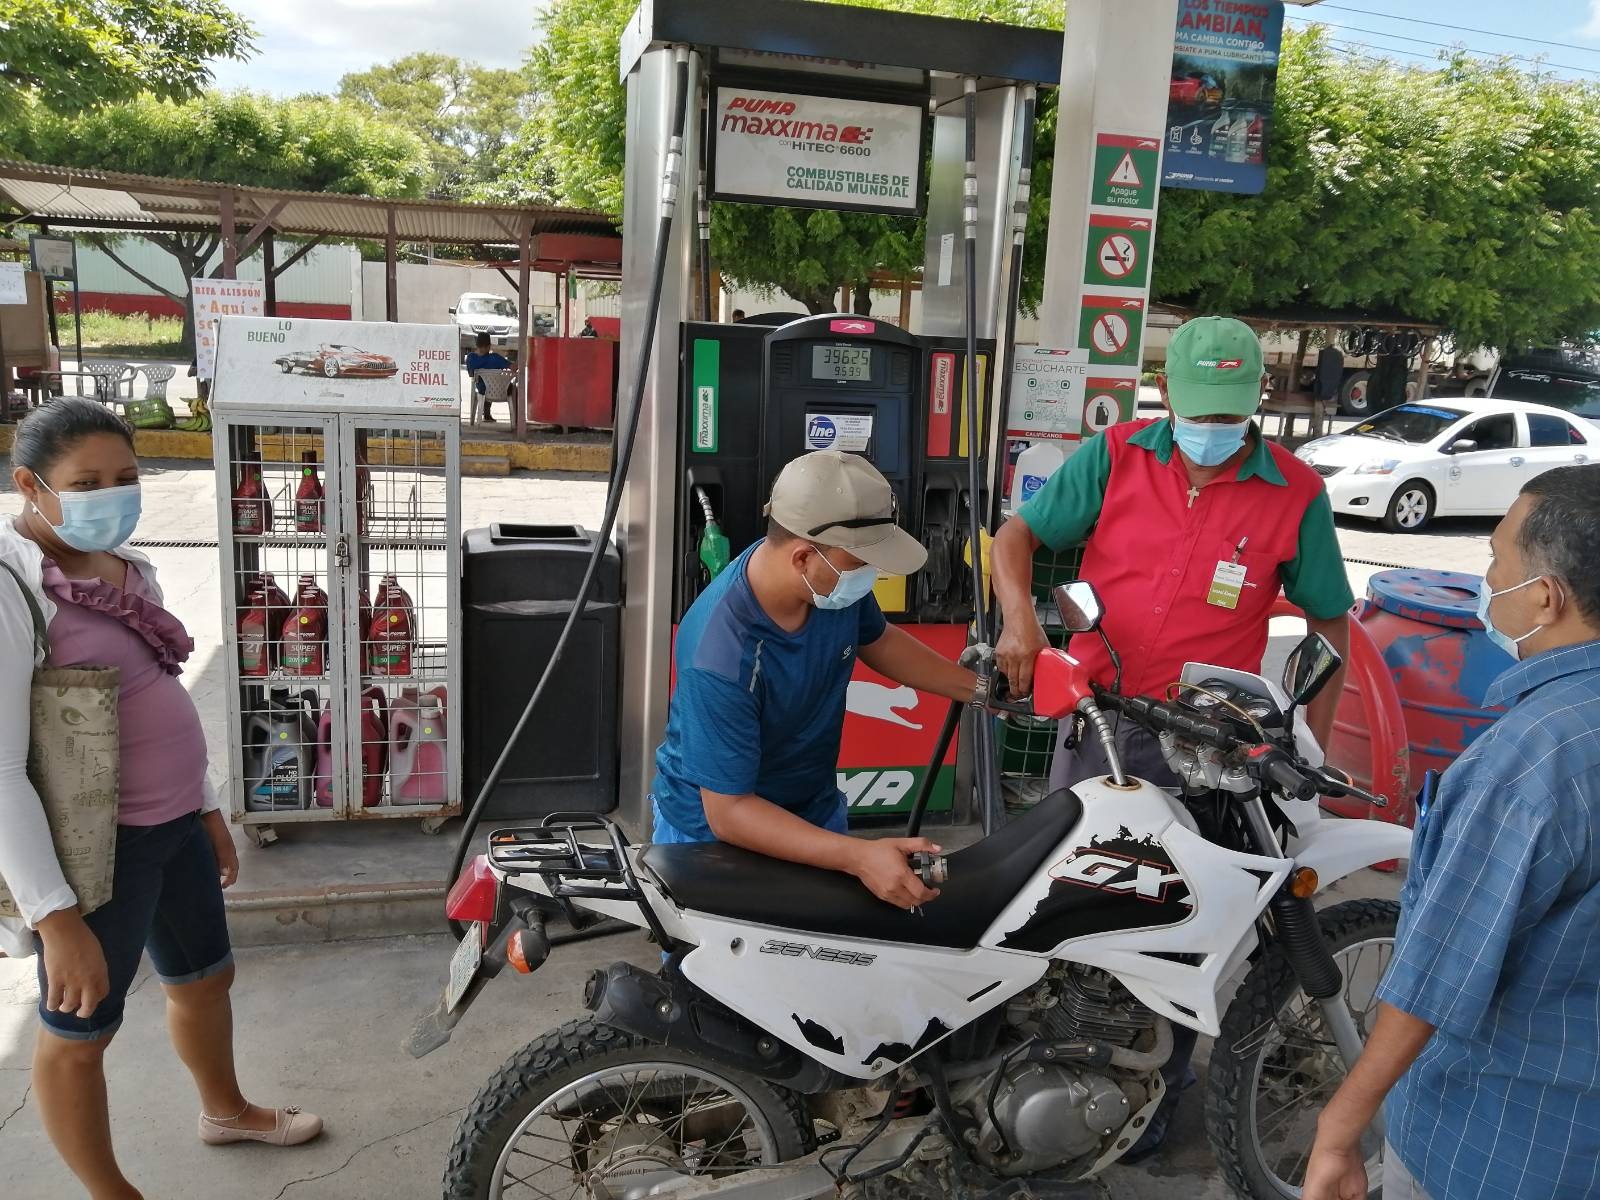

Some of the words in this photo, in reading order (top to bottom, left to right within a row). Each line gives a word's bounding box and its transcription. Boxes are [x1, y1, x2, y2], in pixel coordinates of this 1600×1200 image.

[1177, 10, 1265, 41] AMBIAN,
[1191, 33, 1224, 46] CAMBIA
[1226, 37, 1264, 50] CONTIGO
[1204, 48, 1222, 56] PUMA
[727, 97, 796, 116] PUMA
[721, 113, 838, 142] maxxima
[840, 144, 871, 157] 6600
[787, 165, 889, 186] COMBUSTIBLES
[892, 175, 910, 187] DE
[787, 177, 843, 193] CALIDAD
[847, 183, 909, 198] MUNDIAL
[1110, 186, 1138, 197] Apague
[1117, 197, 1139, 205] motor
[278, 321, 292, 331] LO
[247, 331, 286, 344] BUENO
[418, 349, 451, 361] PUEDE
[410, 361, 430, 372] SER
[1015, 363, 1086, 374] ESCUCHARTE
[402, 373, 448, 386] GENIAL
[381, 644, 407, 652] SUPER
[836, 770, 914, 807] MA
[760, 939, 878, 967] GENESIS
